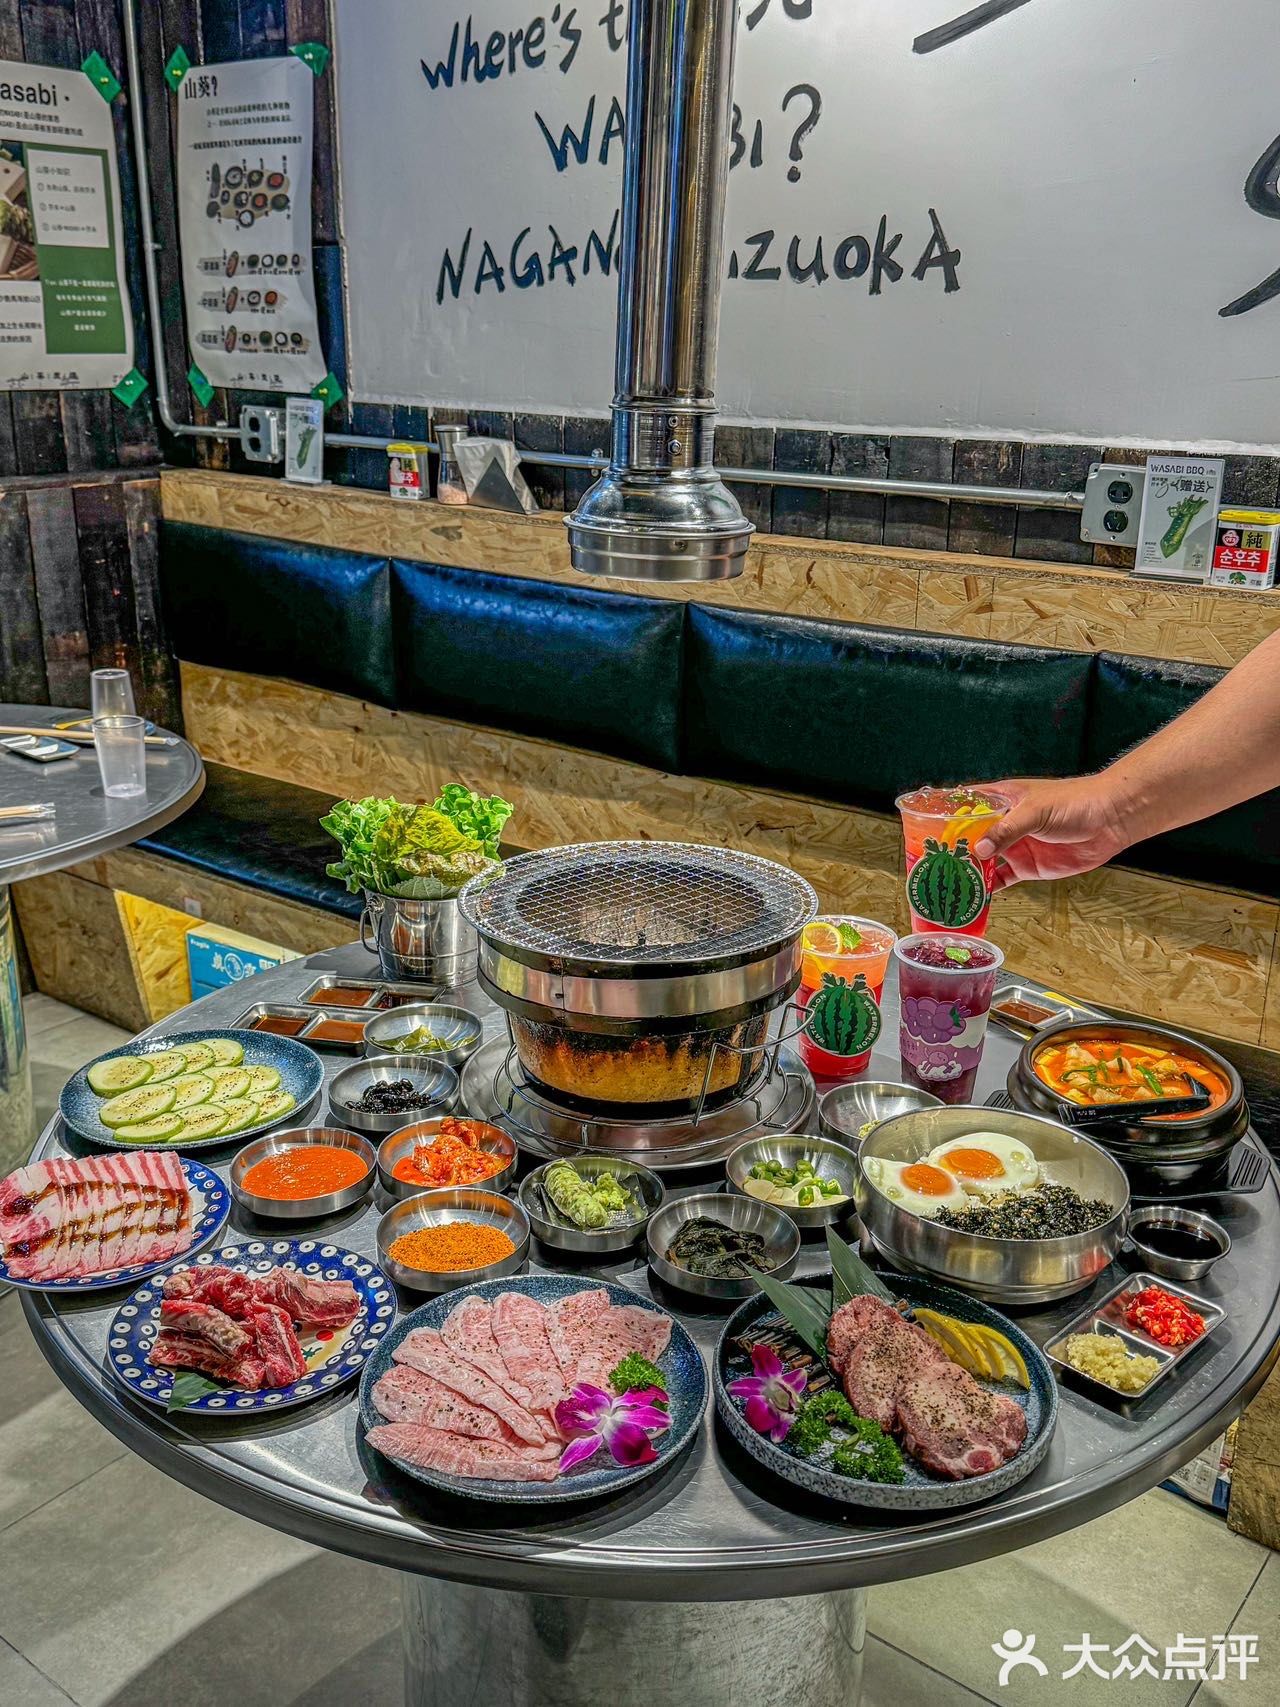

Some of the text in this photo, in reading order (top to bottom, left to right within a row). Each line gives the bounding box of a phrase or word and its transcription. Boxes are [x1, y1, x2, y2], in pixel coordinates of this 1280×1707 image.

[436, 207, 962, 305] NAGAN IZUOKA
[1150, 463, 1205, 476] WASABI BBQ
[1180, 479, 1206, 493] 赠送
[1245, 531, 1264, 549] 純
[1219, 548, 1262, 567] 순후추
[911, 861, 930, 915] WATERMELON
[960, 867, 981, 922] WATERMELON
[809, 993, 878, 1050] WATELON WATERMELON
